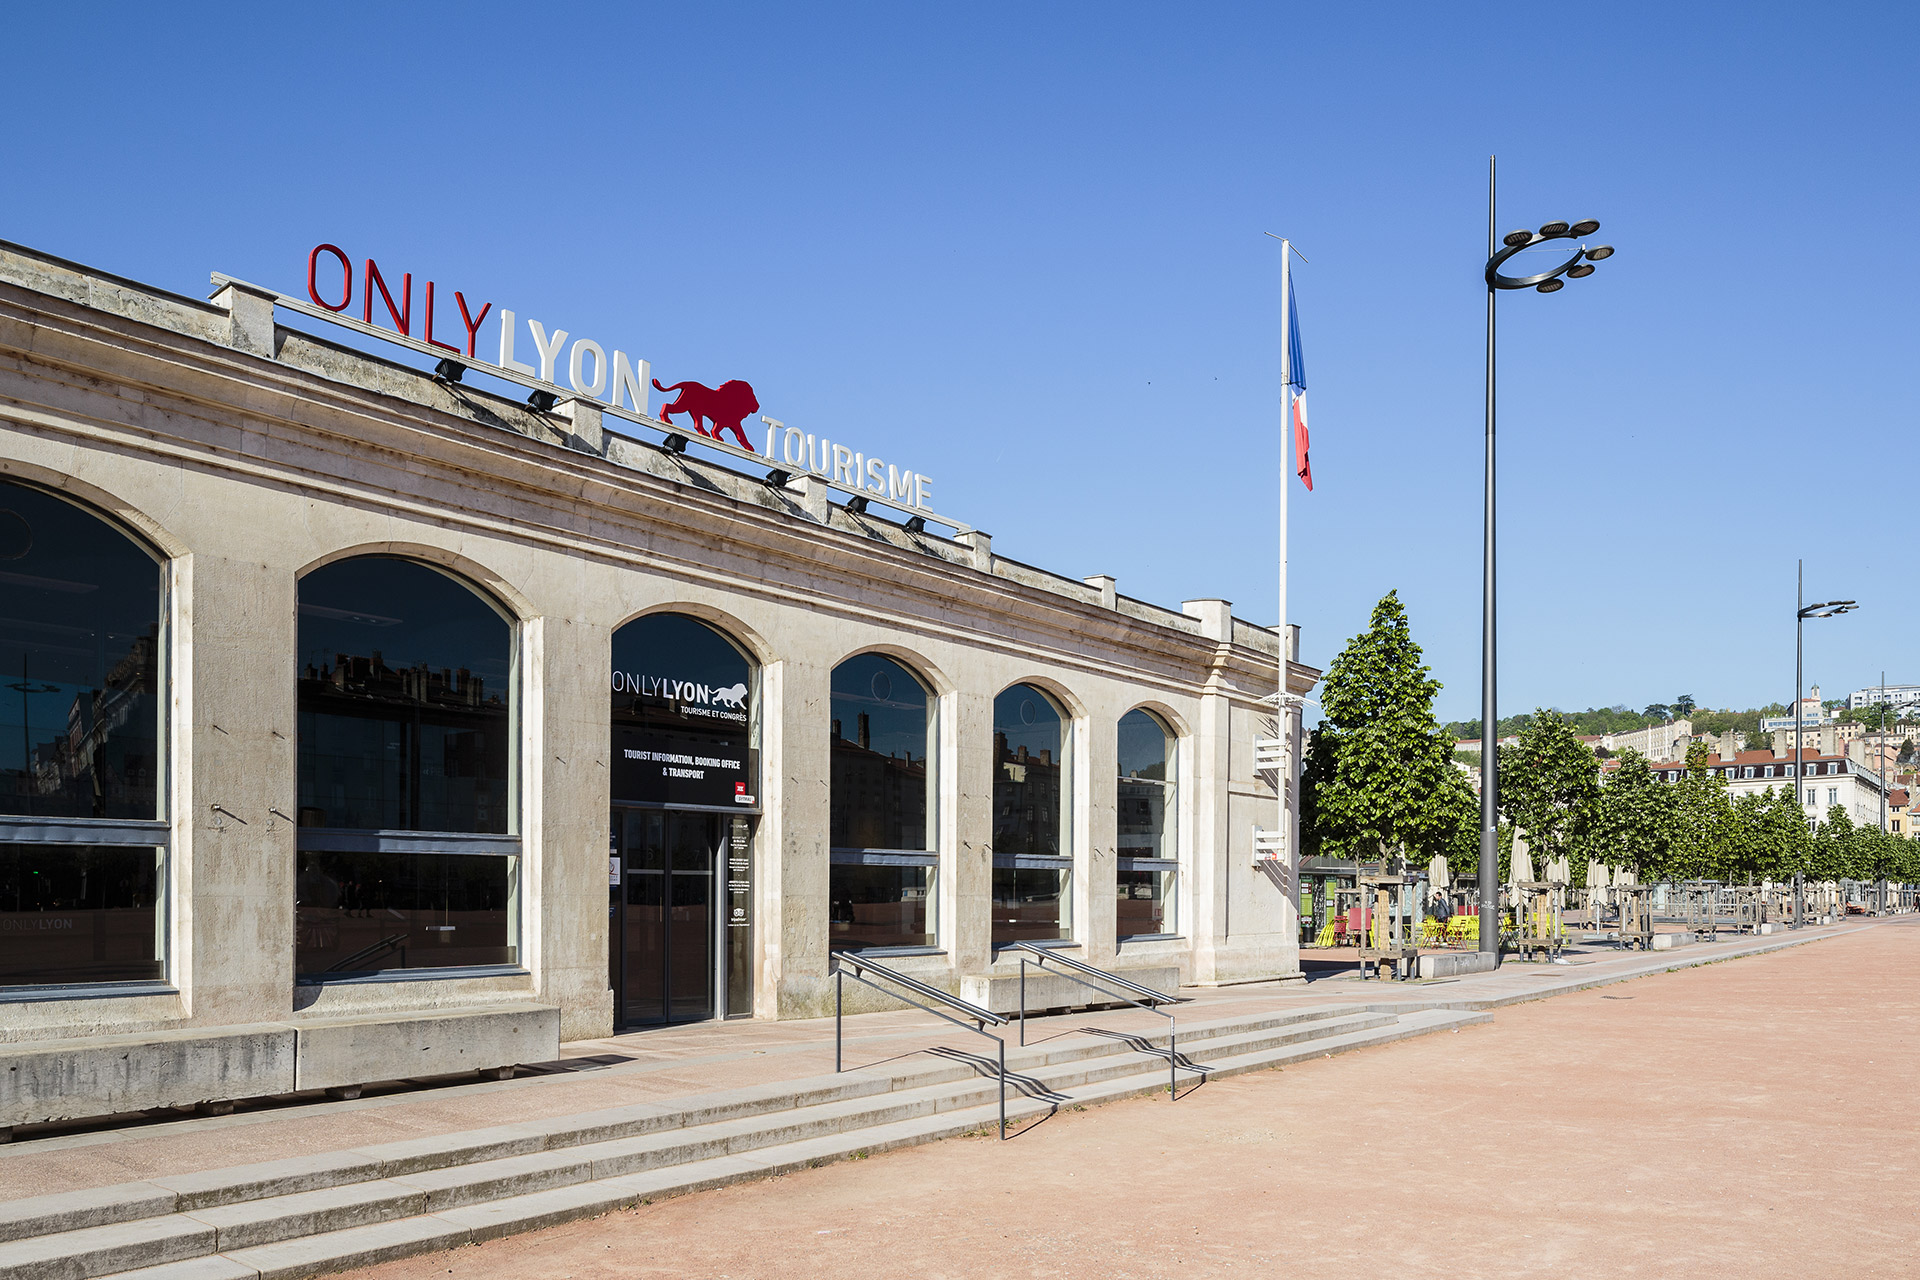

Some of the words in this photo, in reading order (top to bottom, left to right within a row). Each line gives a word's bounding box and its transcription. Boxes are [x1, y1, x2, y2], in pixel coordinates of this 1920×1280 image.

[761, 415, 934, 513] TOURISME
[681, 705, 711, 717] TOURISME
[720, 711, 747, 721] CONGRÈS
[624, 749, 651, 760] TOURIST
[652, 751, 695, 766] INFORMATION,
[695, 756, 721, 768] BOOKING
[721, 759, 741, 770] OFFICE
[662, 767, 668, 776] &
[669, 767, 704, 779] TRANSPORT
